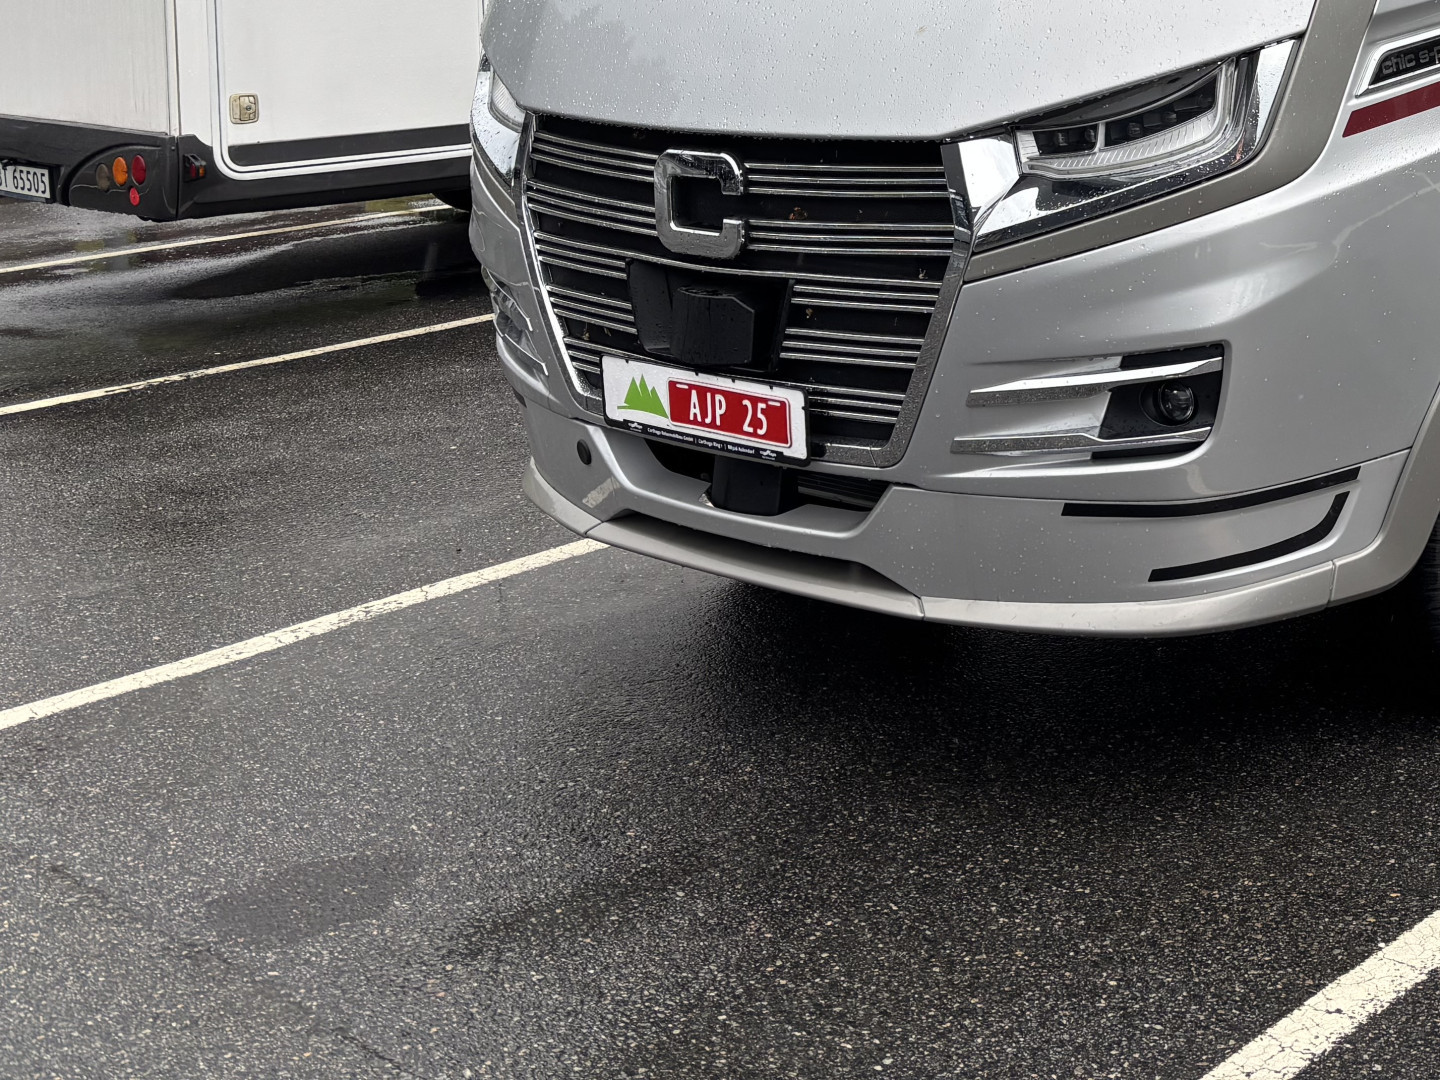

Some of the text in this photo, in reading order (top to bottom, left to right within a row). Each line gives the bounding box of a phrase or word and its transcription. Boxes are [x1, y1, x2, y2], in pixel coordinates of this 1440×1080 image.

[1381, 52, 1416, 74] chic
[13, 167, 47, 195] 65505
[689, 389, 768, 436] AJP 25
